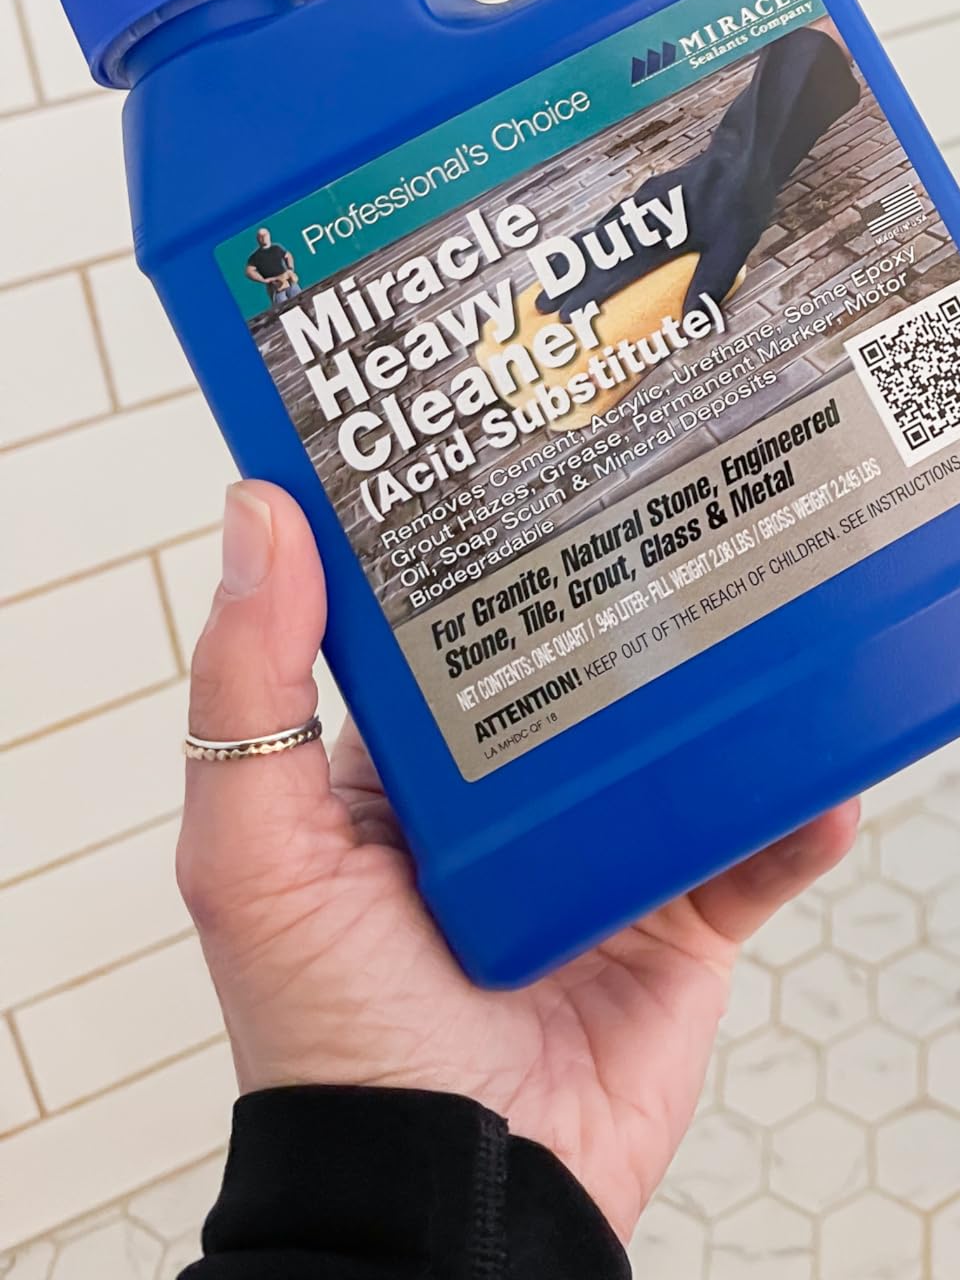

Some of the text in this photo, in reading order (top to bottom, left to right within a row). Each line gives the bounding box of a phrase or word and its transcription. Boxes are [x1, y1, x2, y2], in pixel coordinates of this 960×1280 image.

[689, 1, 812, 69] Sealants Company
[301, 91, 590, 254] Professional's Choice
[875, 228, 898, 245] MADE
[279, 202, 541, 363] Miracle
[305, 185, 688, 423] Heavy Duty
[338, 300, 602, 471] Cleaner
[360, 292, 725, 522] (Acid Substitute)
[381, 244, 914, 549] Removes Cement, Acrylic, Urethane, Some Epoxy
[391, 267, 906, 567] Grout Hazes, Grease, Permanent Marker, Motor
[397, 369, 777, 587] Oil, Soap Scum & Mineral Deposits
[409, 517, 554, 608] Biodegradable
[431, 398, 840, 651] For Granite, Natural Stone, Engineered
[445, 459, 795, 679] Stone, Tile, Grout, Glass & Metal
[456, 685, 480, 711] NET
[477, 656, 535, 700] CONTENTS:
[531, 642, 557, 669] ONE
[552, 622, 589, 656] QUART
[647, 576, 674, 603] FILL
[668, 552, 712, 590] WEIGHT
[708, 541, 735, 568] 2.08
[730, 529, 755, 555] LBS
[757, 505, 796, 539] GROSS
[791, 482, 834, 519] WEIGHT
[830, 469, 861, 499] 2.245
[856, 457, 881, 483] LBS
[474, 668, 583, 744] ATTENTION!
[583, 651, 617, 680] KEEP
[621, 632, 649, 659] OUT
[651, 620, 670, 642] OF
[669, 604, 701, 630] THE
[699, 577, 748, 614] REACH
[747, 565, 766, 586] OF
[768, 526, 840, 574] CHILDREN.
[839, 508, 868, 534] SEE
[497, 728, 529, 751] MHDC
